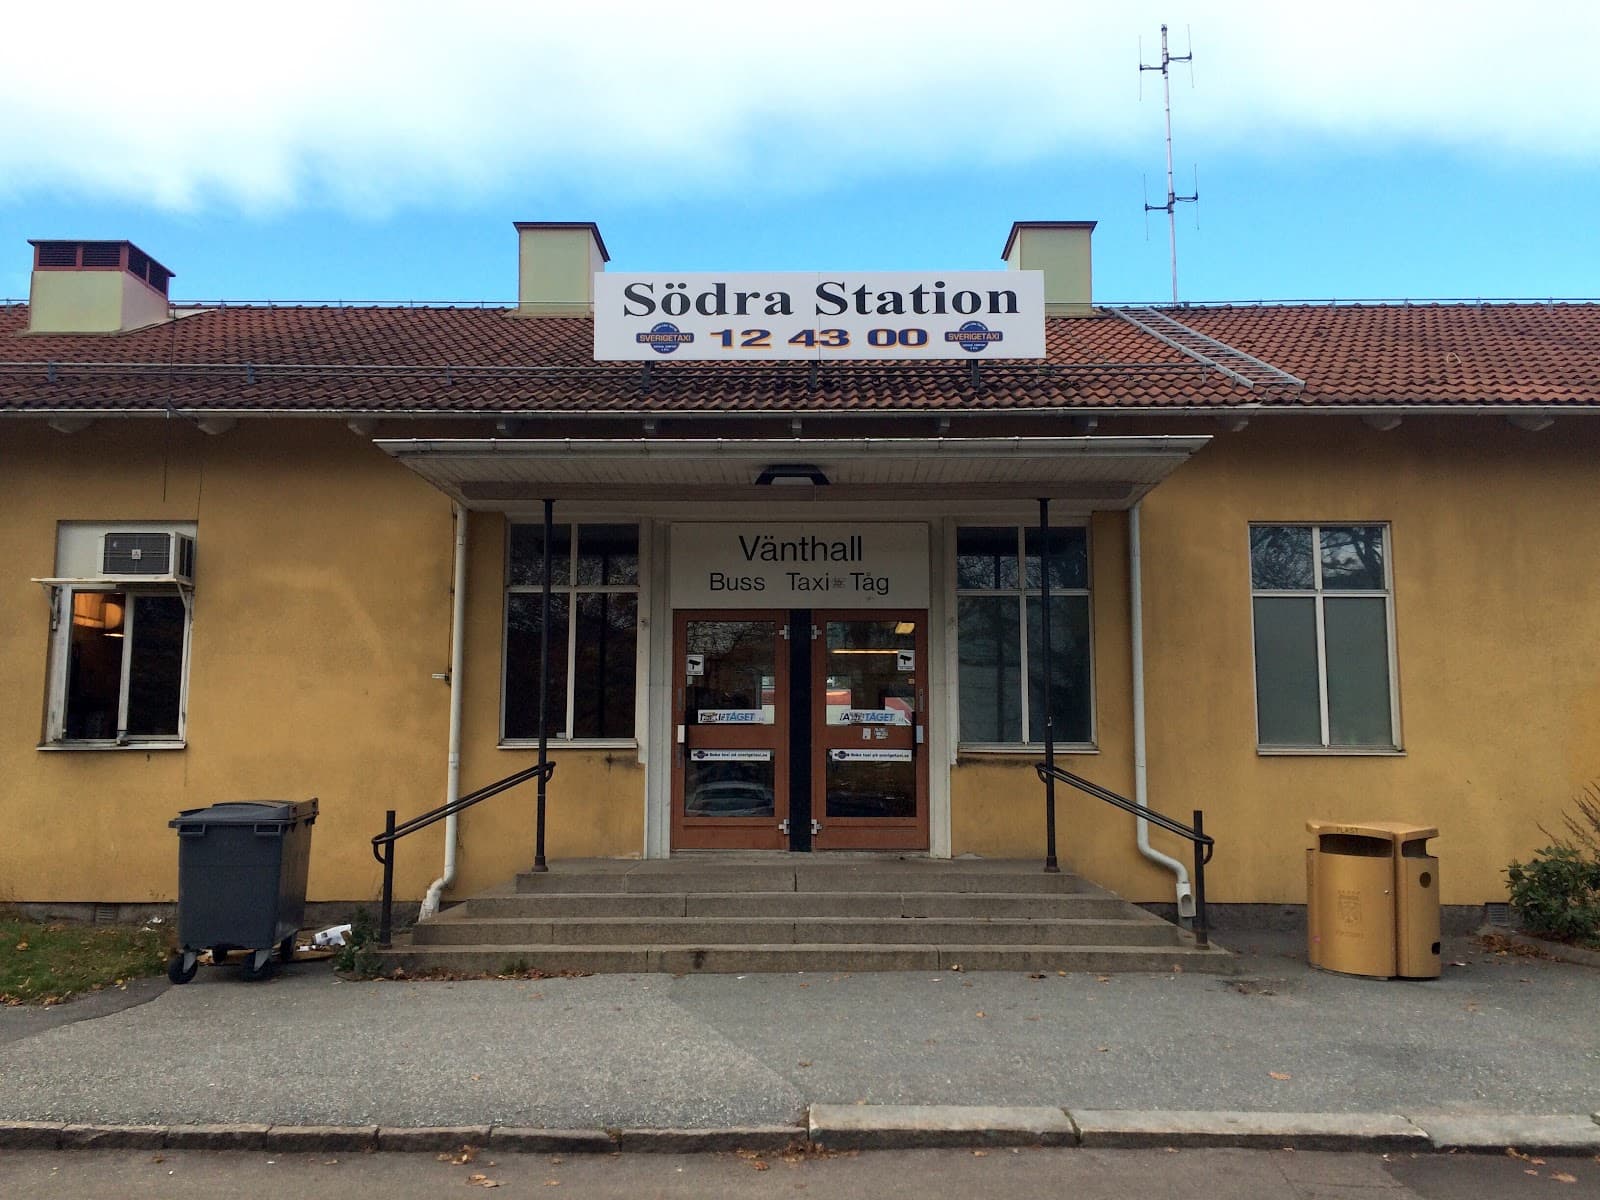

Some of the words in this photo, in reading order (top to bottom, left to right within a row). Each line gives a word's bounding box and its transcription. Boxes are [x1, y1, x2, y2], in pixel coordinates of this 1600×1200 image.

[623, 282, 794, 317] Södra
[815, 280, 1020, 316] Station
[638, 333, 692, 343] SVERIGETAXI
[710, 328, 772, 348] 12
[787, 328, 850, 348] 43
[866, 328, 929, 347] 00
[947, 332, 1001, 342] SVERIGETAXI
[738, 535, 863, 562] Vänthall
[709, 572, 766, 592] Buss
[786, 572, 829, 591] Taxi
[849, 572, 889, 596] Tåg
